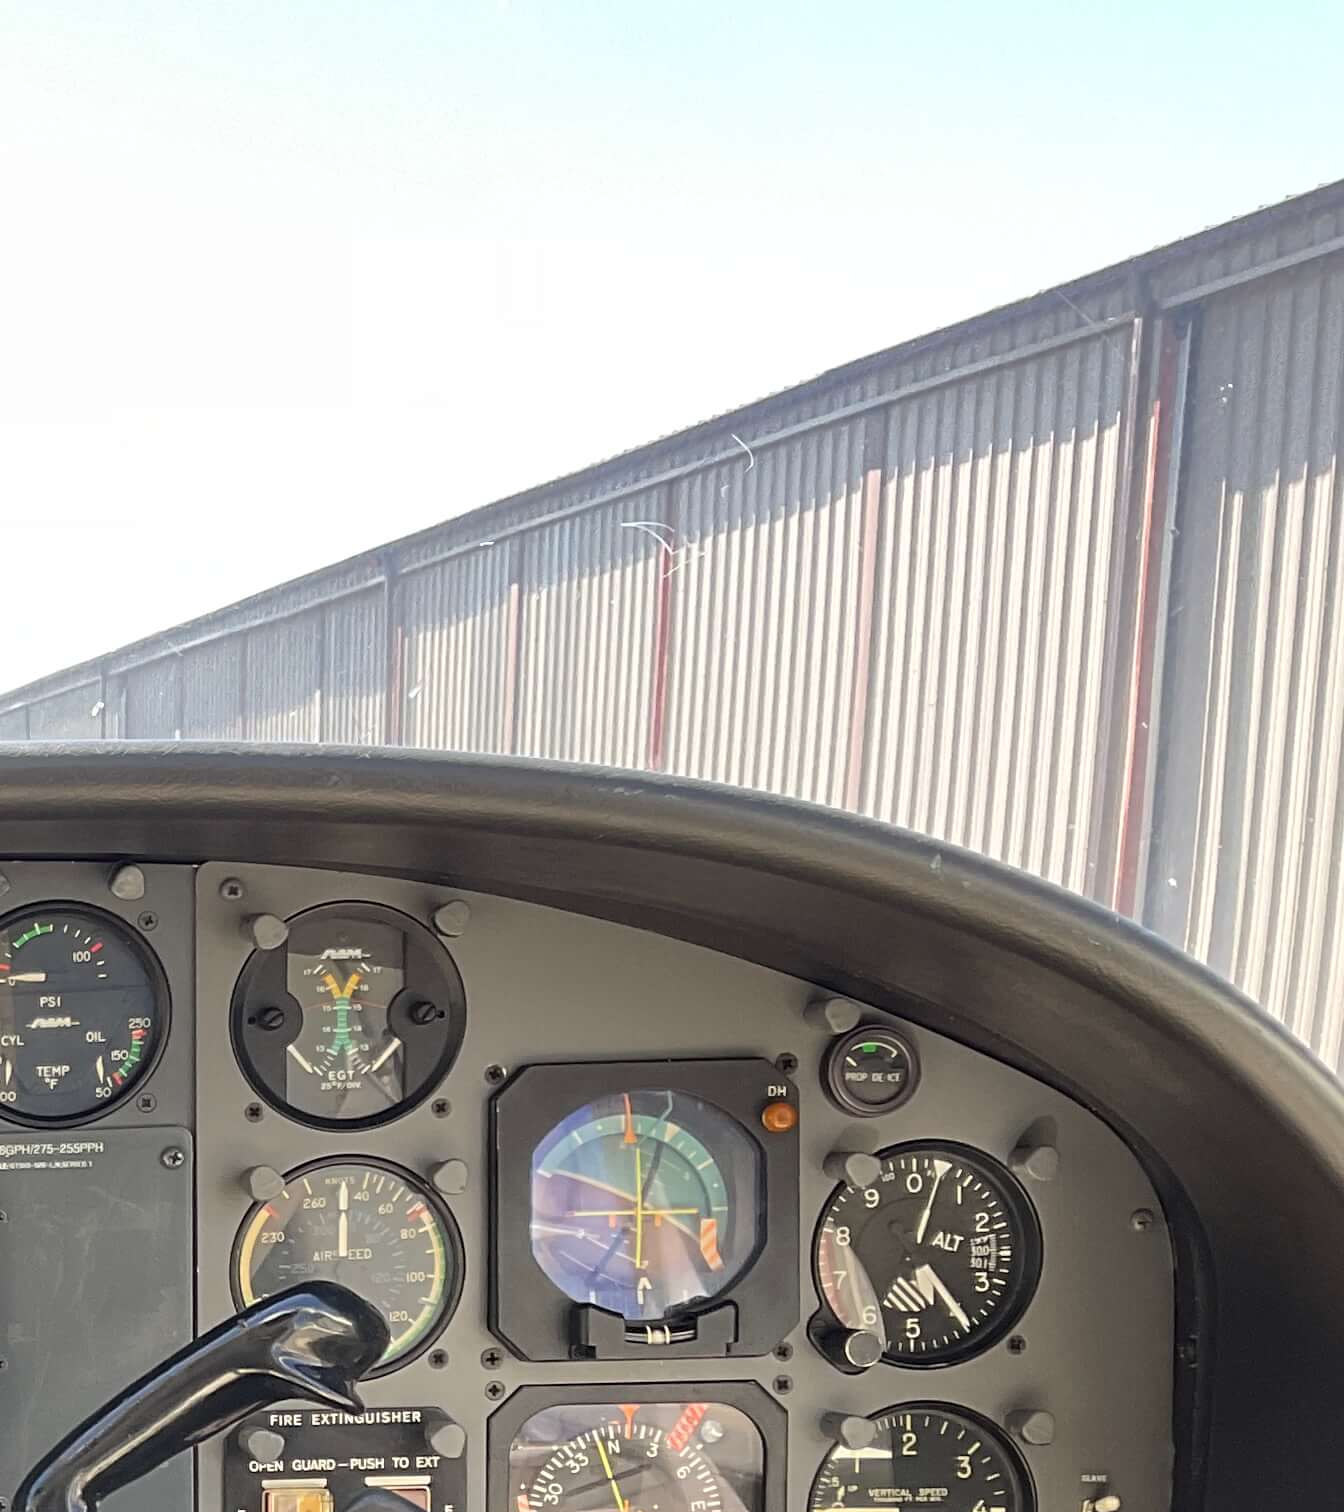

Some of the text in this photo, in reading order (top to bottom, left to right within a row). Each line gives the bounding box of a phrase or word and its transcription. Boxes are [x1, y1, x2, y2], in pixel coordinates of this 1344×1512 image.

[0, 1034, 25, 1046] CYL
[37, 1065, 70, 1078] TEMP
[328, 1070, 355, 1082] EGT
[768, 1085, 787, 1097] DH
[931, 1232, 964, 1252] ALT
[270, 1411, 422, 1426] FIRE EXTINGUISHER
[392, 1456, 409, 1468] TO
[415, 1456, 440, 1468] EXT
